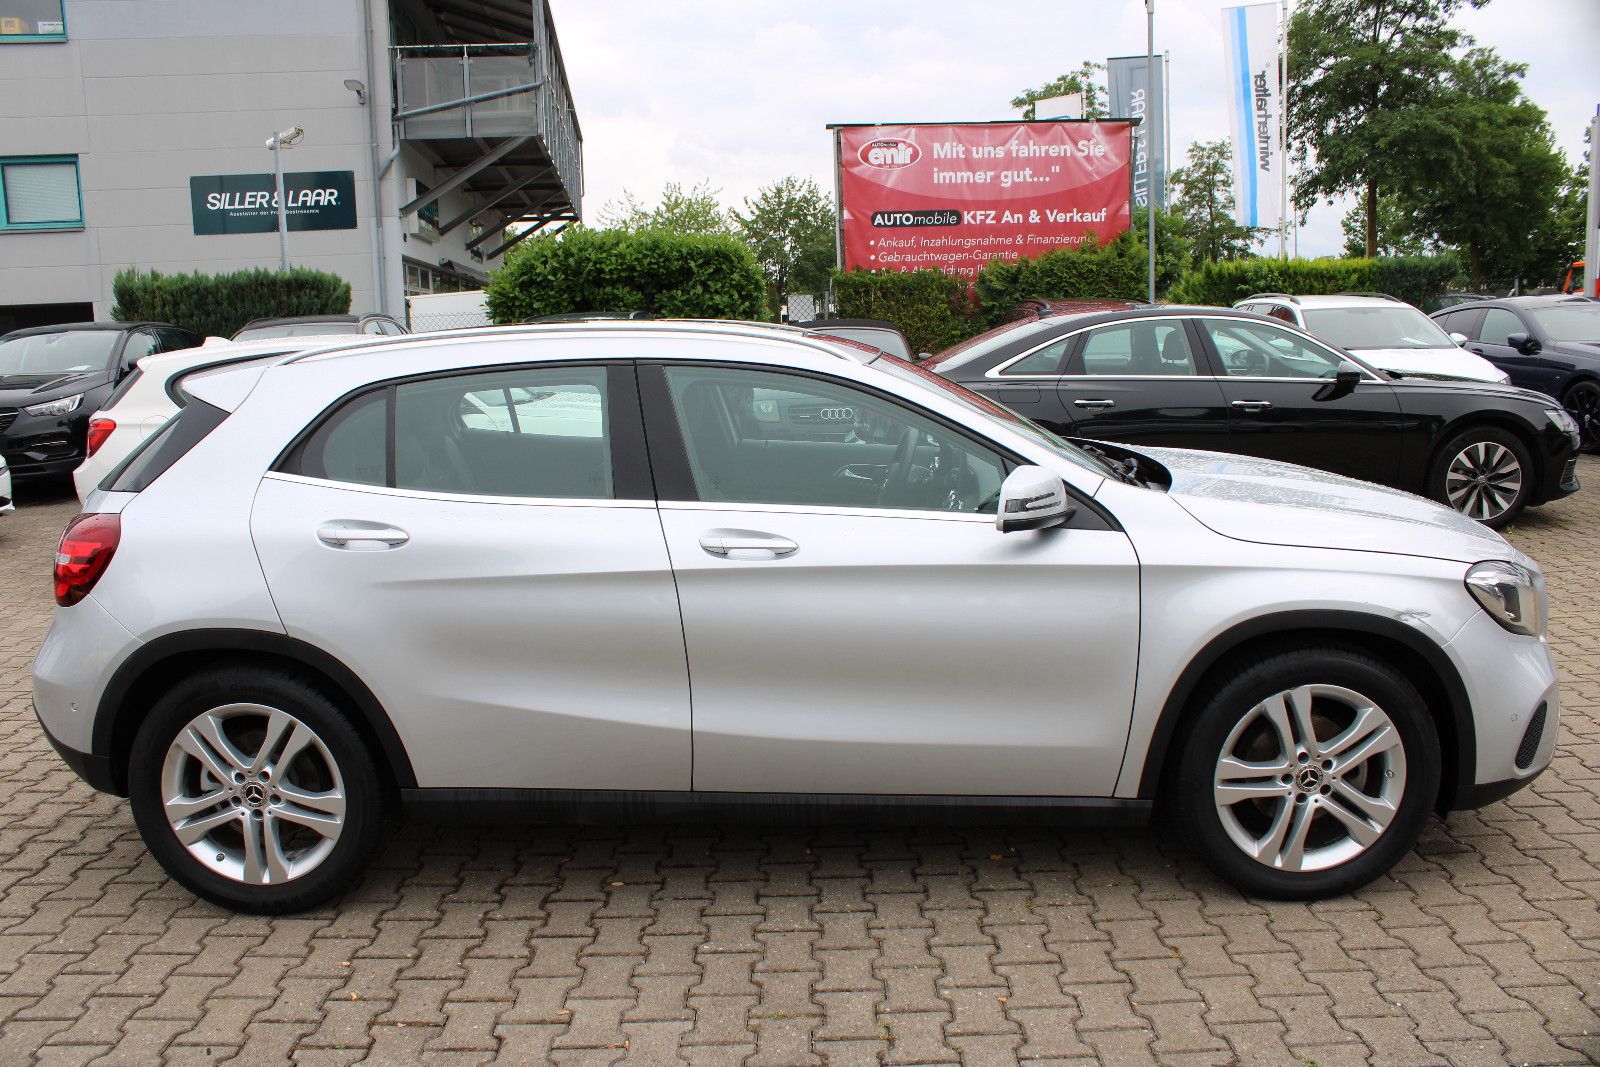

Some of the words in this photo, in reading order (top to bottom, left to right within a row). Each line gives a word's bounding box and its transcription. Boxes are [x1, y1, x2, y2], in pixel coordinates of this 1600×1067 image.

[868, 143, 913, 165] emir
[933, 142, 966, 159] Mit
[972, 145, 1005, 158] uns
[1010, 140, 1072, 158] fahren
[1077, 138, 1105, 157] Sie
[933, 167, 994, 184] immer
[206, 191, 270, 210] SILLER
[288, 188, 338, 207] LAAR
[873, 212, 958, 226] AUTOmobile
[963, 210, 996, 225] KFZ
[1001, 210, 1023, 224] An
[1028, 209, 1040, 224] &
[1046, 207, 1107, 223] Verkauf
[877, 236, 917, 248] Ankauf,
[920, 234, 1013, 249] Inzahlungsnahme
[1015, 234, 1024, 245] &
[878, 249, 1018, 264] Gebrauchtwagen-Garantie
